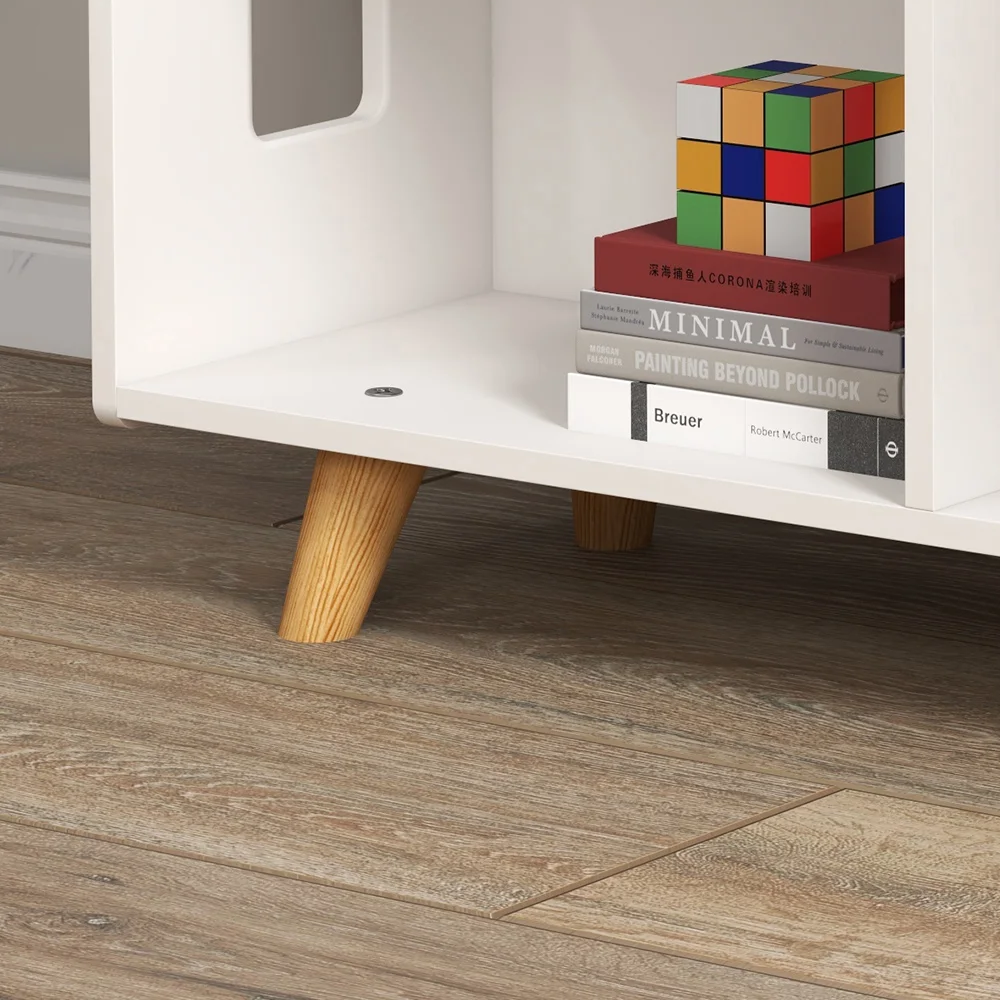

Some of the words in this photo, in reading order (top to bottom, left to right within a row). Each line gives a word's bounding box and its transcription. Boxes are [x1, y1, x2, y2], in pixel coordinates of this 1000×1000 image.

[648, 308, 796, 350] MINIMAL
[589, 344, 620, 356] MORGAN
[814, 339, 831, 348] Simple
[839, 342, 866, 352] Sustainable
[586, 354, 623, 366] FALCONER
[634, 350, 709, 380] PAINTING
[715, 362, 779, 389] BEYOND
[785, 371, 861, 401] POLLOCK
[654, 408, 703, 428] Breuer
[750, 425, 780, 438] Robert
[782, 430, 823, 444] McCarter
